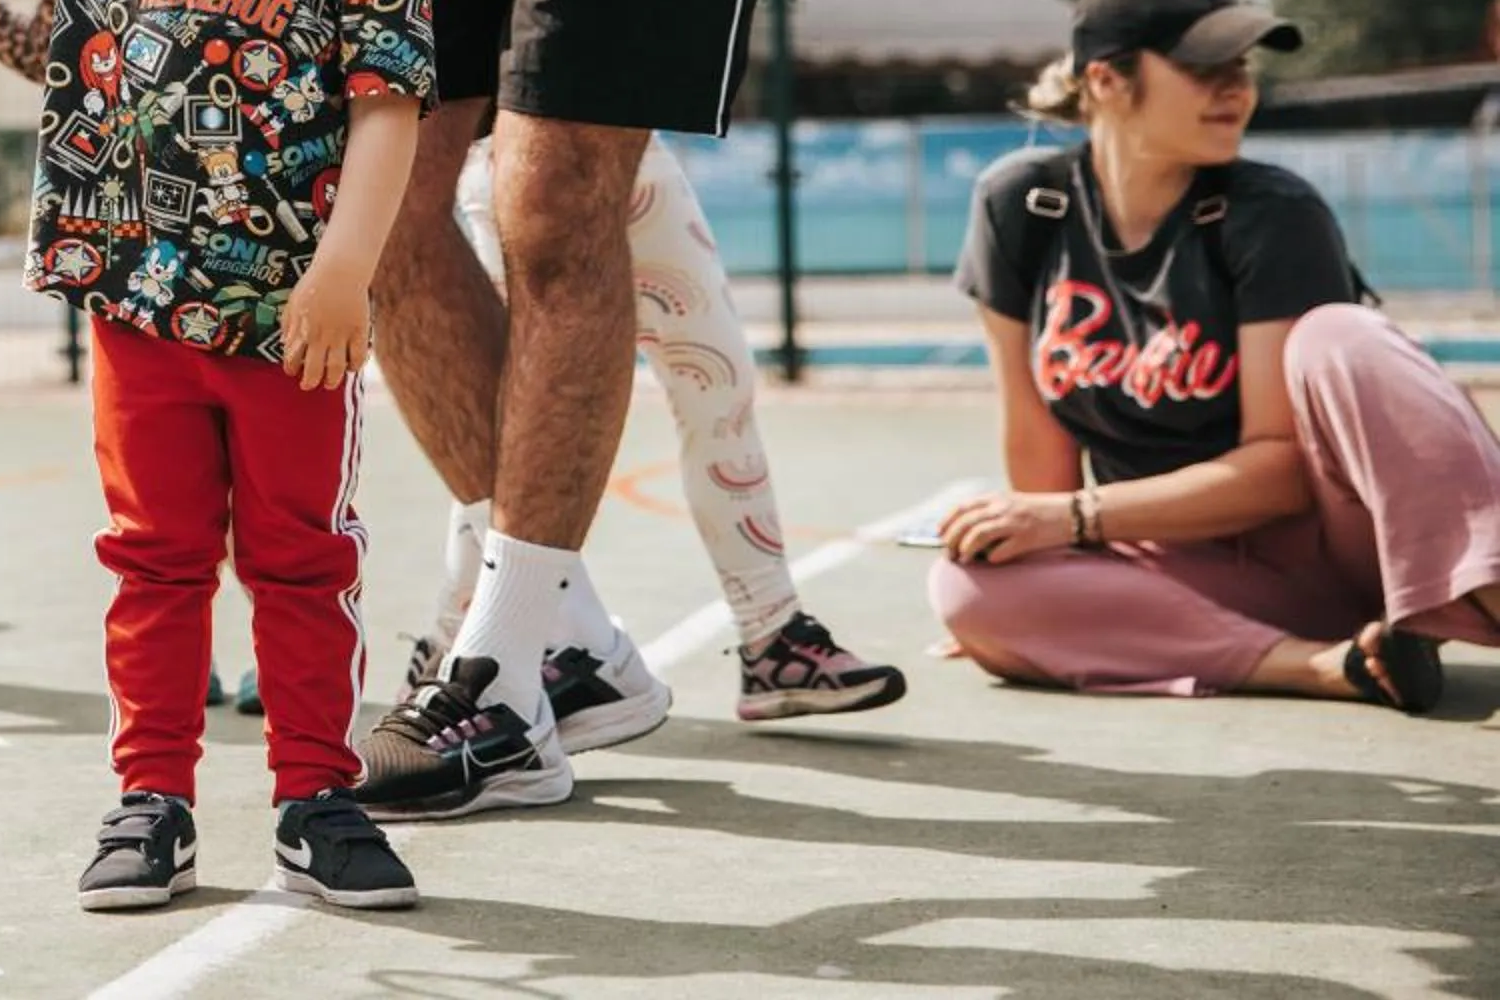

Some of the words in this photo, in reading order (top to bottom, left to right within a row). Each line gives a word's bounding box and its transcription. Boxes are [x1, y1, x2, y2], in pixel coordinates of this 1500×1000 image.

[190, 225, 290, 269] SONIC
[202, 256, 284, 286] HEDGEHOG
[1033, 280, 1238, 409] Barbie
